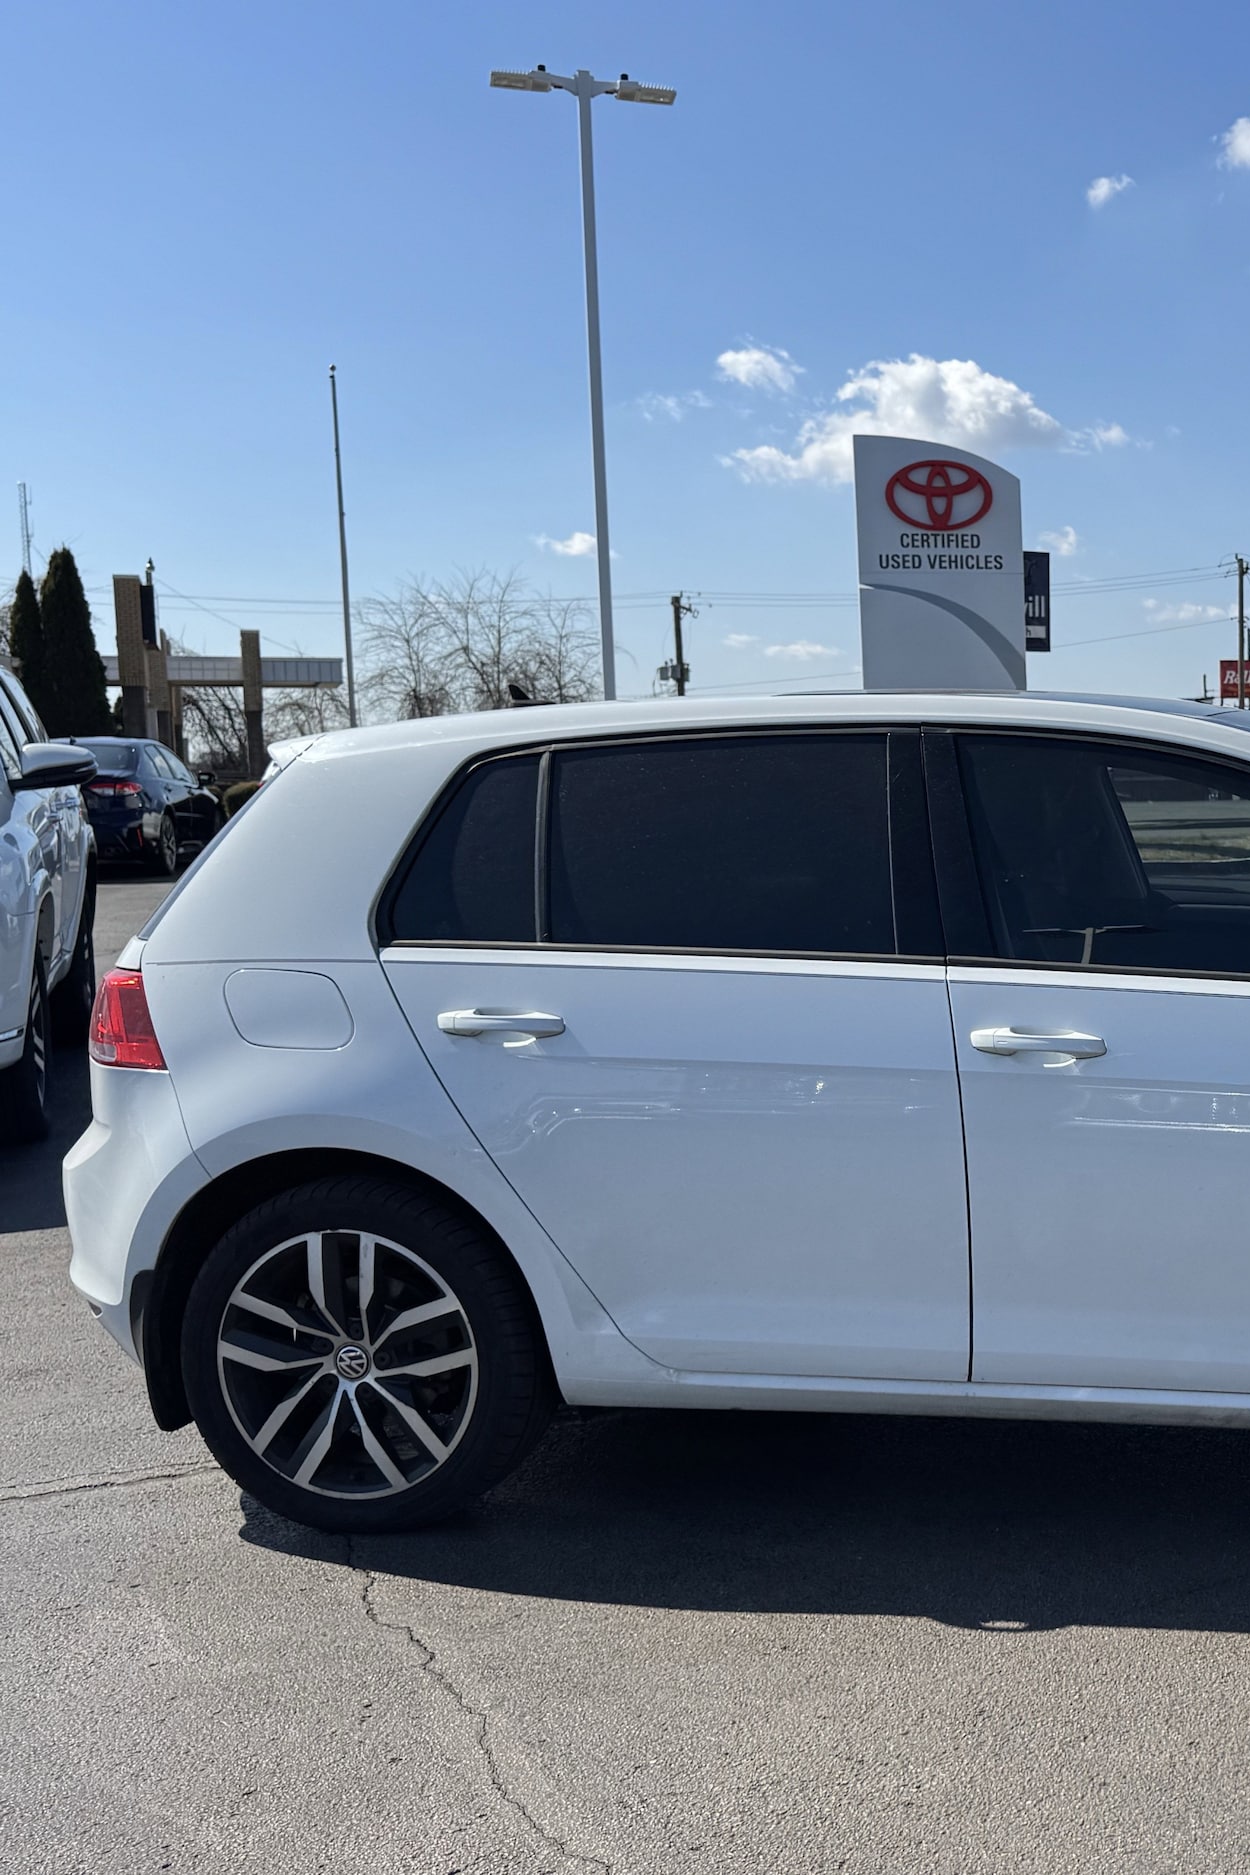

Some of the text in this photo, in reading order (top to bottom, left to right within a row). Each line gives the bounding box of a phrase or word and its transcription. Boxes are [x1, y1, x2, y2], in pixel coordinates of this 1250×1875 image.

[900, 533, 981, 549] CERTIFIED
[879, 554, 1004, 570] USED VEHICLES
